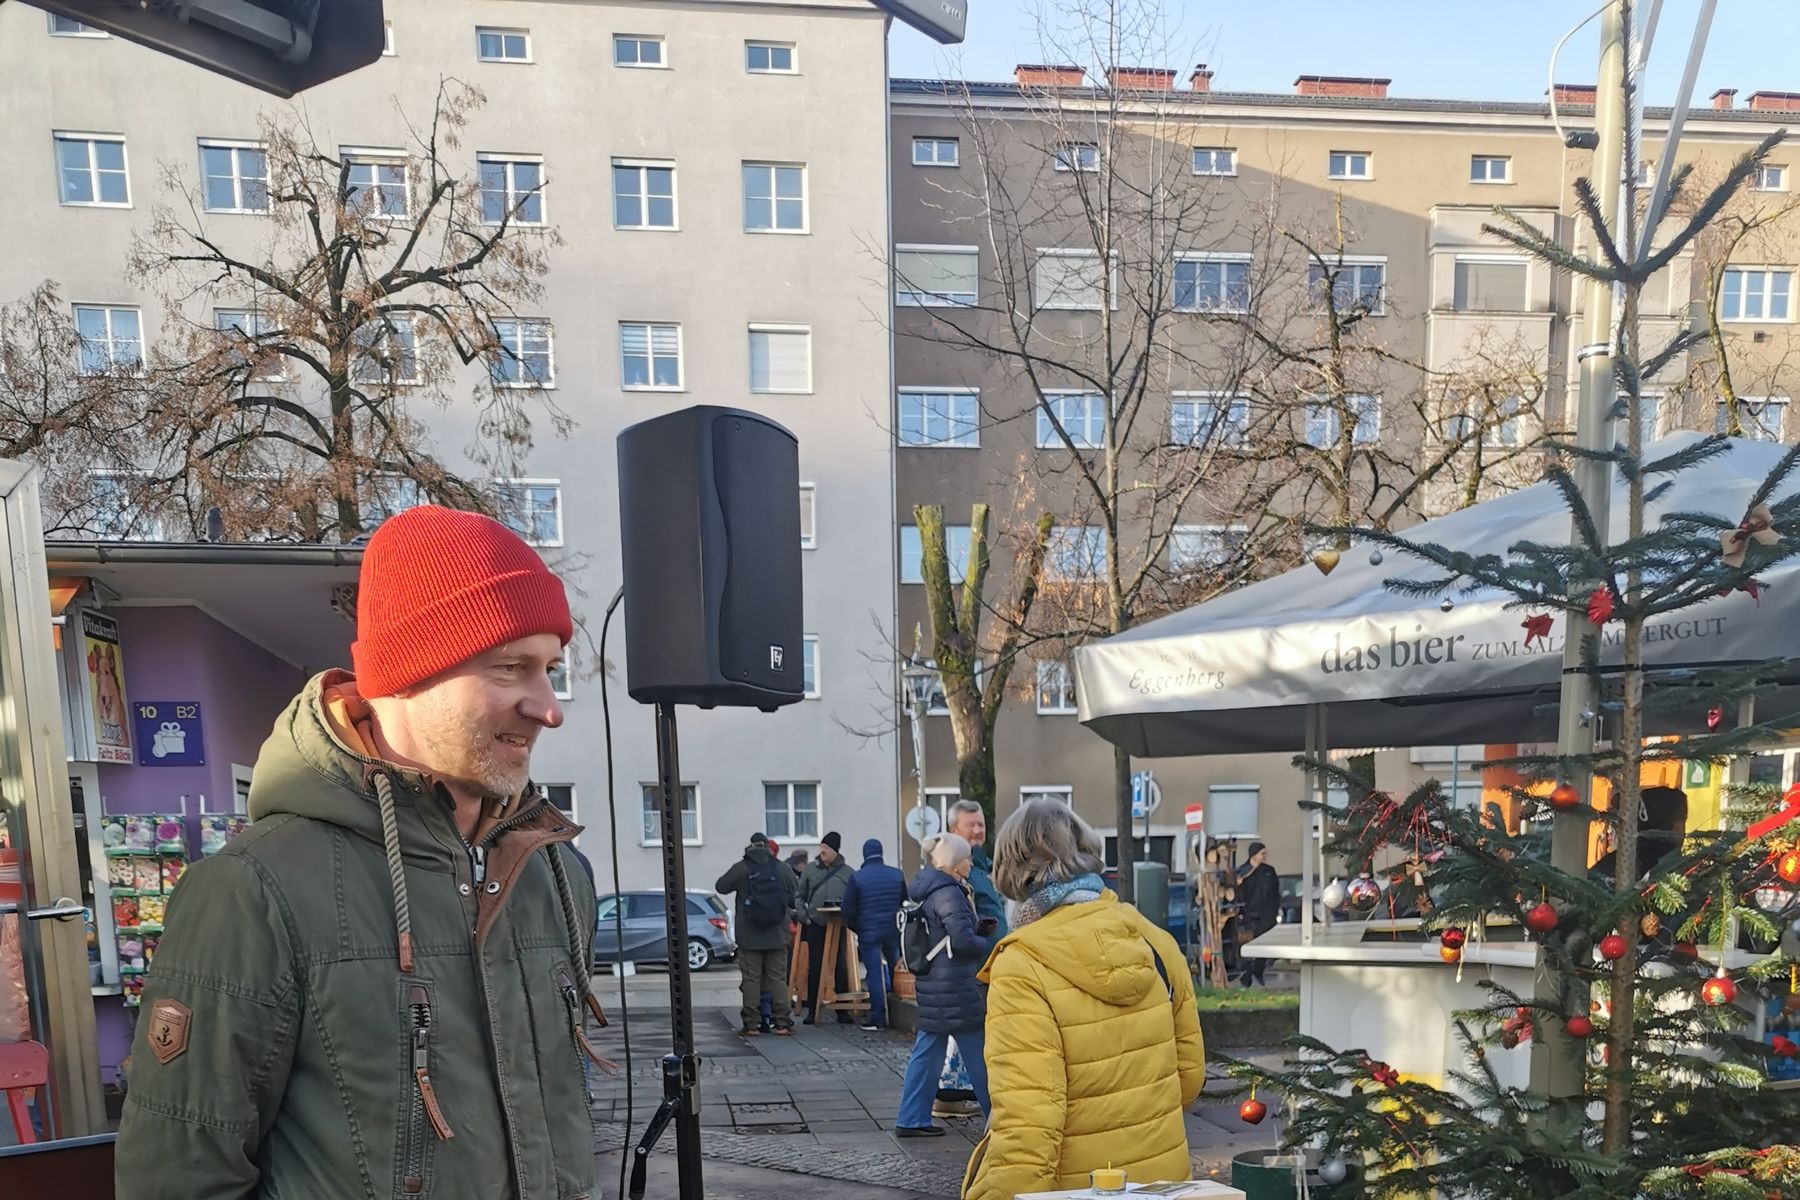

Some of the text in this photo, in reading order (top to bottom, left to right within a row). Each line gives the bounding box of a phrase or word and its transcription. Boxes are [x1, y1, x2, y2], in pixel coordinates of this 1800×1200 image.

[1321, 616, 1727, 674] das bier ZUM SALMERGUT
[1129, 668, 1226, 695] Eggenberg
[139, 706, 197, 719] 10 B2
